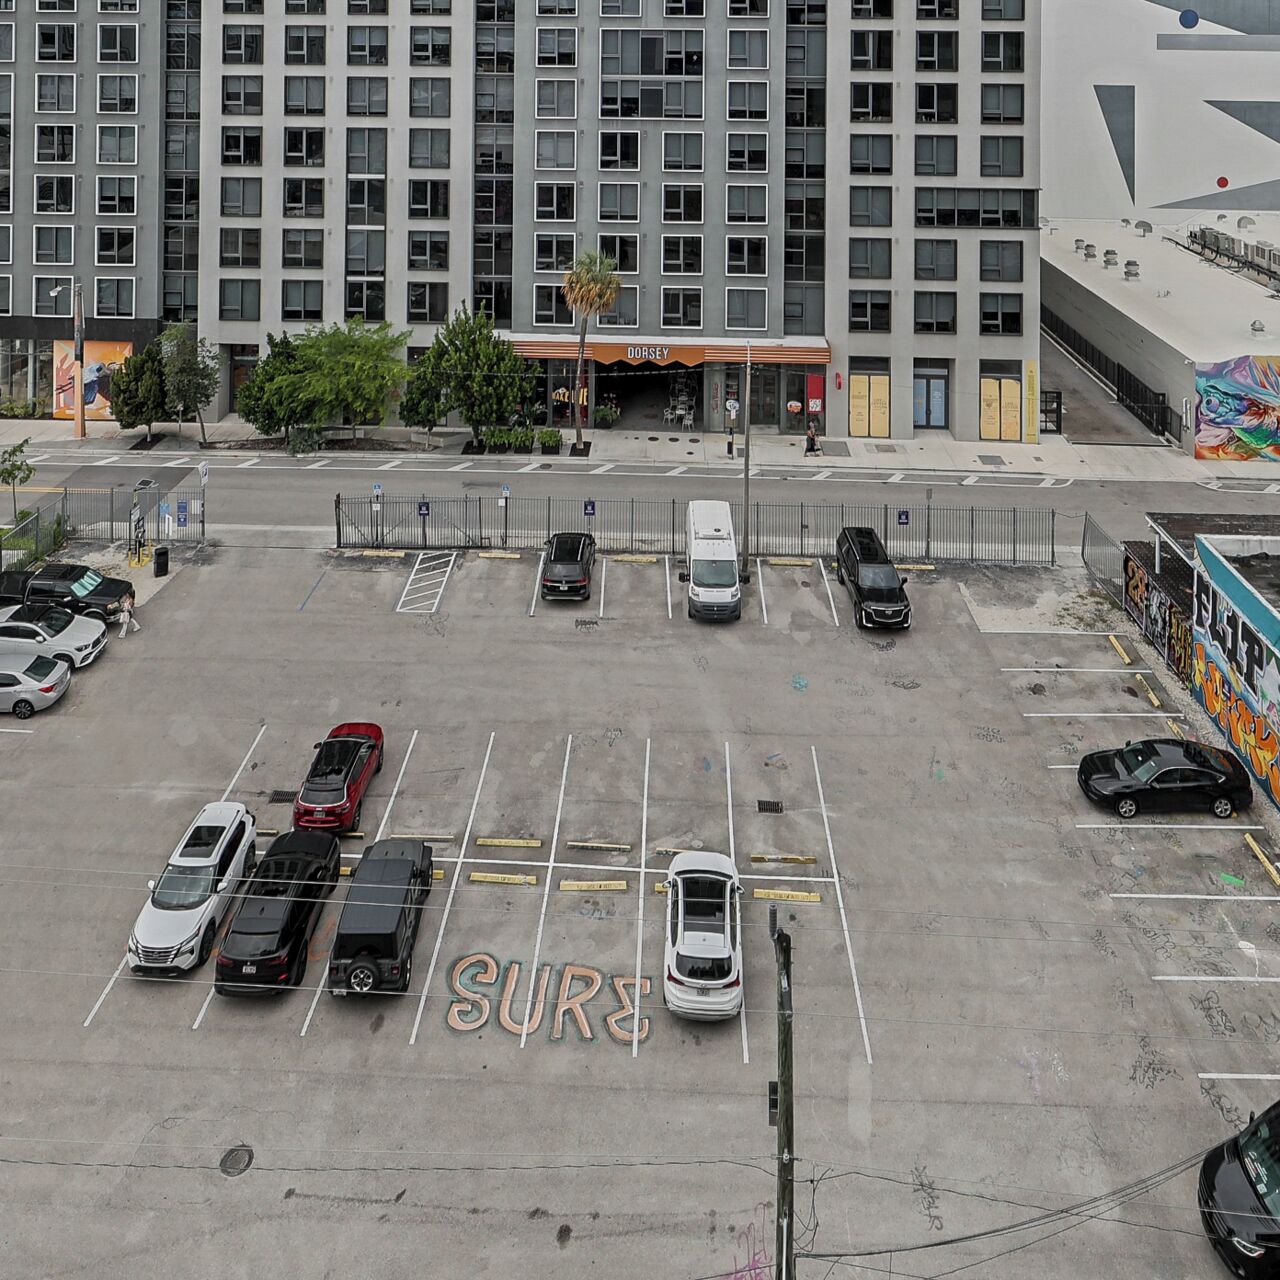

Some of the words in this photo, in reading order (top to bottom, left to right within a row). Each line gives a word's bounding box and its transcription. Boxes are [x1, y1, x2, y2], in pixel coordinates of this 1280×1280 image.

[627, 347, 669, 359] DORSEY
[1193, 569, 1266, 702] FLIP
[447, 952, 652, 1043] SURE
